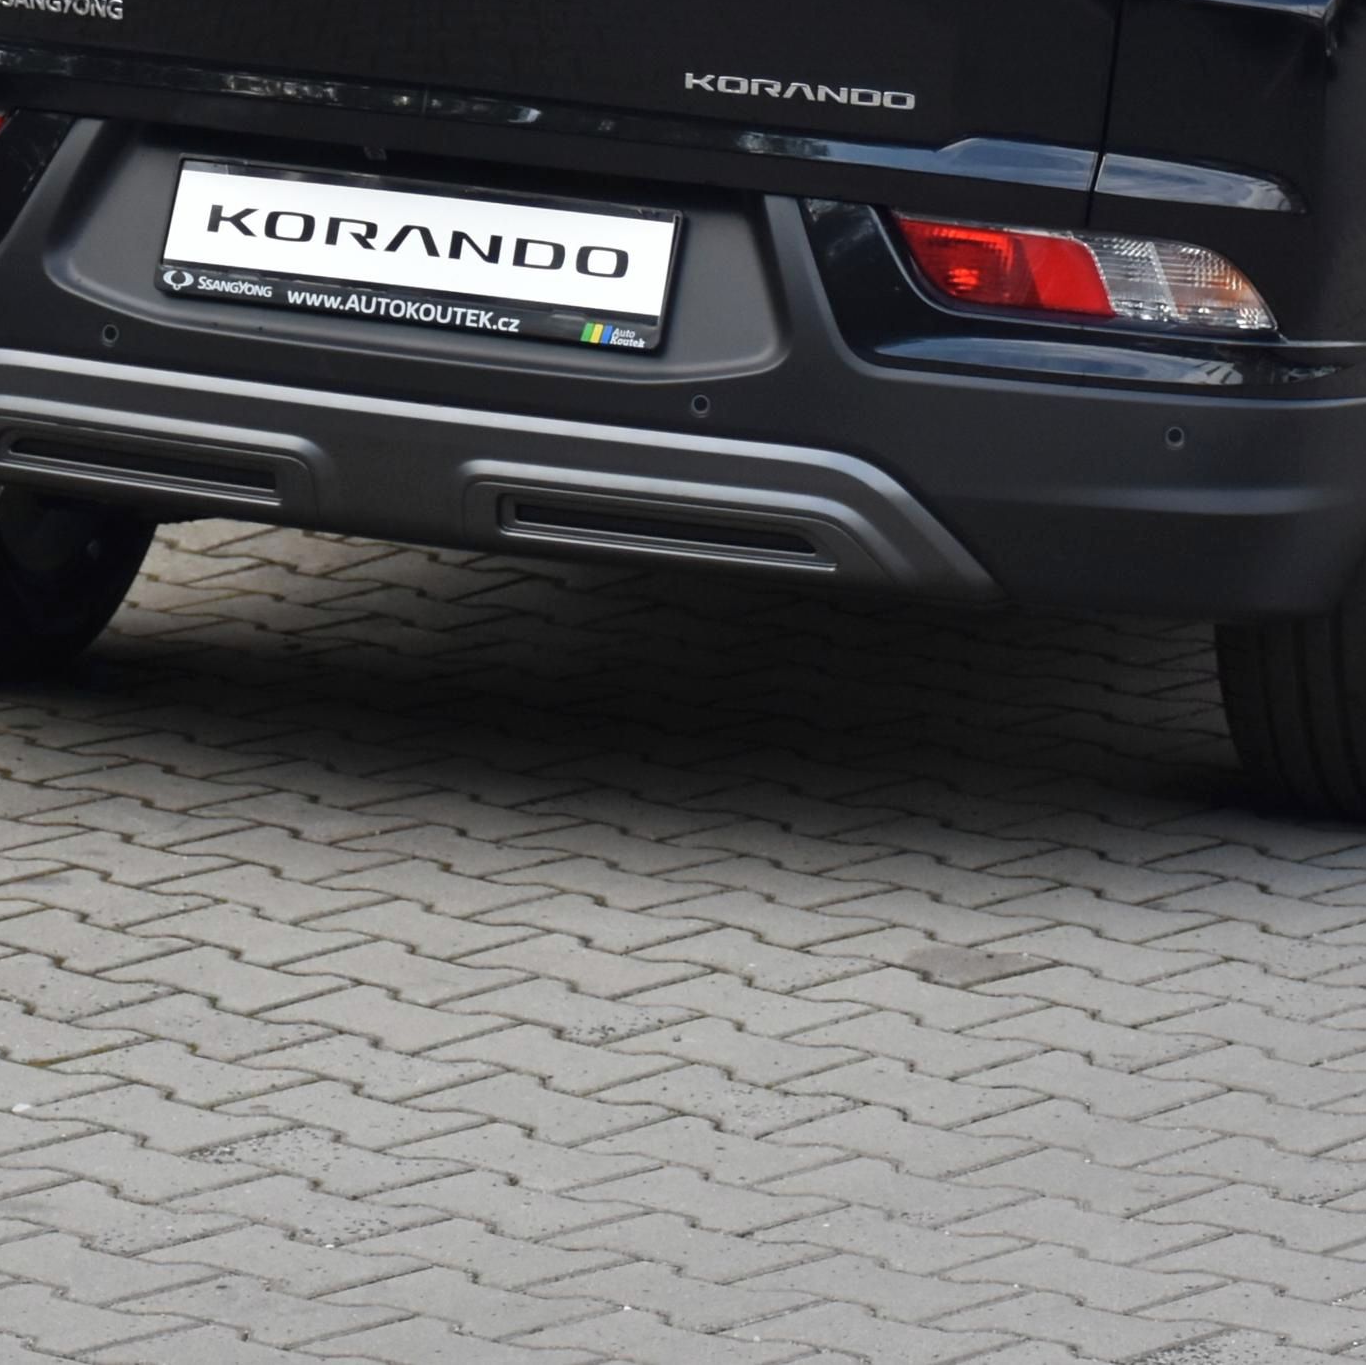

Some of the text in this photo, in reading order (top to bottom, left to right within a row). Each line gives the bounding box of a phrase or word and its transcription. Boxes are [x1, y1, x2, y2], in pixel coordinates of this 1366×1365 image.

[684, 72, 916, 110] KORANDO
[205, 203, 630, 280] KORANDO
[287, 289, 521, 333] www.AUTOKOUTEK.cz
[609, 335, 645, 348] Koutek
[612, 327, 636, 339] Auto
